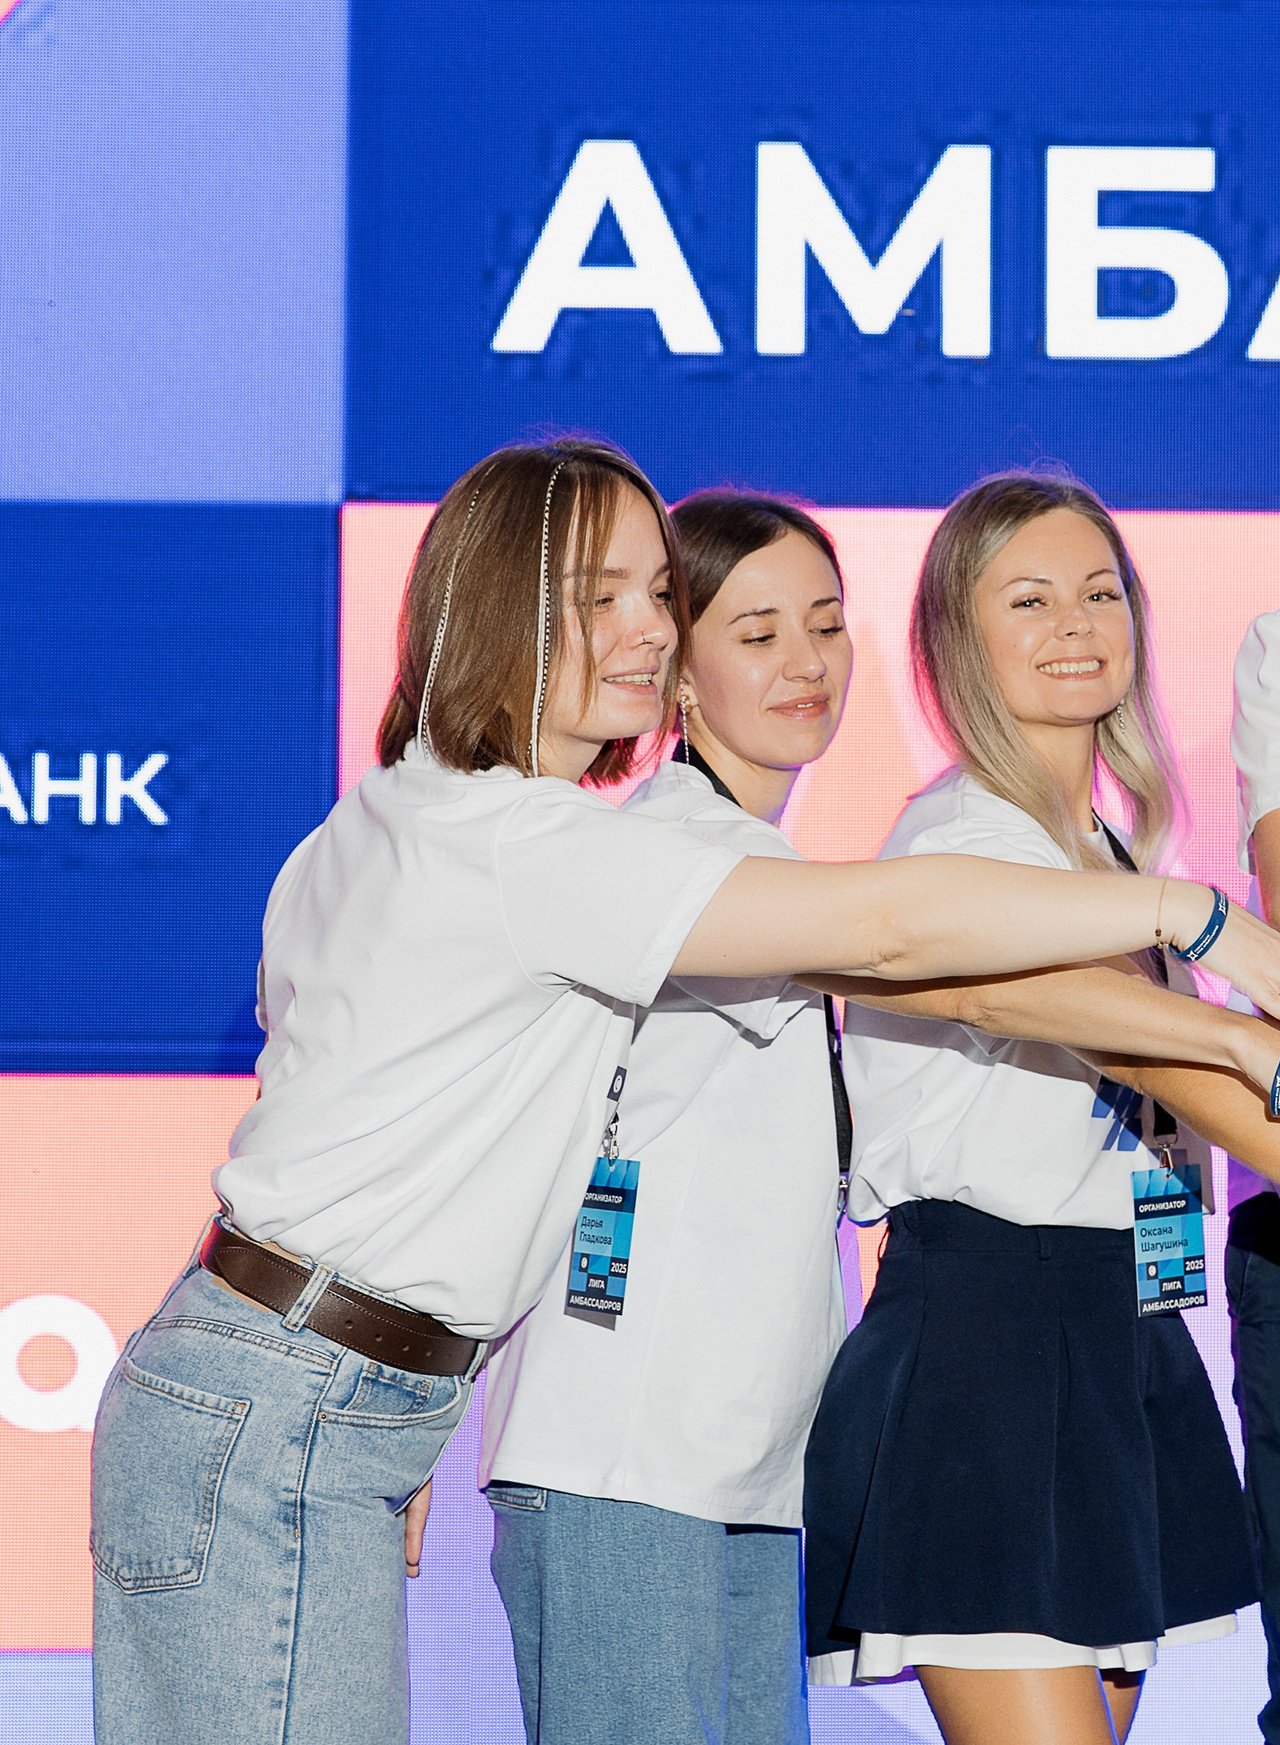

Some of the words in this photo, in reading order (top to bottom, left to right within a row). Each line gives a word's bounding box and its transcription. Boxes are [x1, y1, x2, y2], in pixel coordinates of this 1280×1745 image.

[585, 1193, 622, 1203] ОРГАНИЗАТОР
[1139, 1200, 1186, 1213] ОРГАНИЗАТОР
[581, 1216, 604, 1230] Дарья
[1140, 1226, 1173, 1238] Оксана
[579, 1231, 612, 1246] Гладкова
[1141, 1238, 1188, 1252] Шагушина
[610, 1262, 627, 1274] 2025
[1185, 1259, 1204, 1271] 2025
[588, 1278, 605, 1289] ЛИГА
[1162, 1281, 1182, 1291] ЛИГА
[570, 1295, 621, 1311] АМБАССАДОРОВ
[1142, 1295, 1205, 1313] АМБАССАДОРОВ
